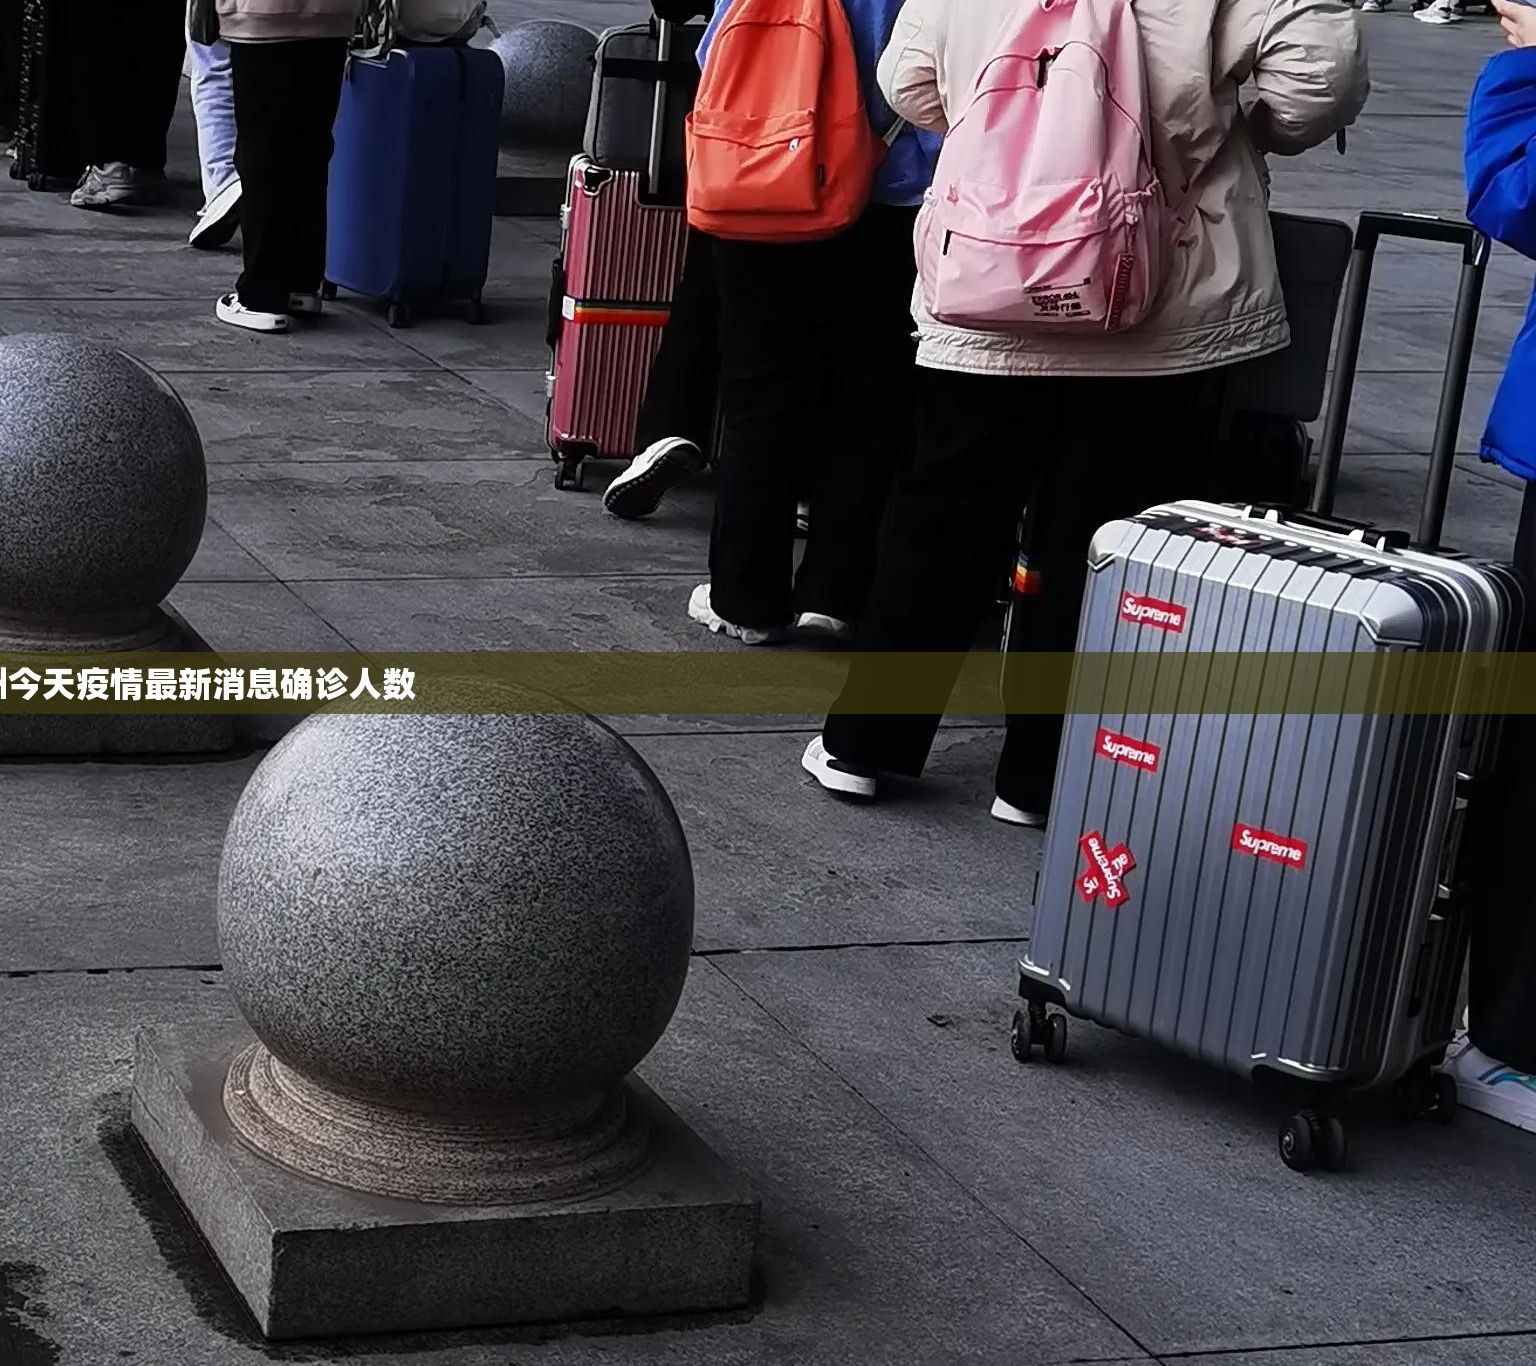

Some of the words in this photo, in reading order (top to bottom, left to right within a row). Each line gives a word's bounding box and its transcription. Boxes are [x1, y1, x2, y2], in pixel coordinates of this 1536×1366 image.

[1122, 597, 1182, 626] Supreme
[1102, 734, 1156, 765] Supreme
[1239, 829, 1302, 861] Supreme
[1088, 838, 1121, 899] Supreme
